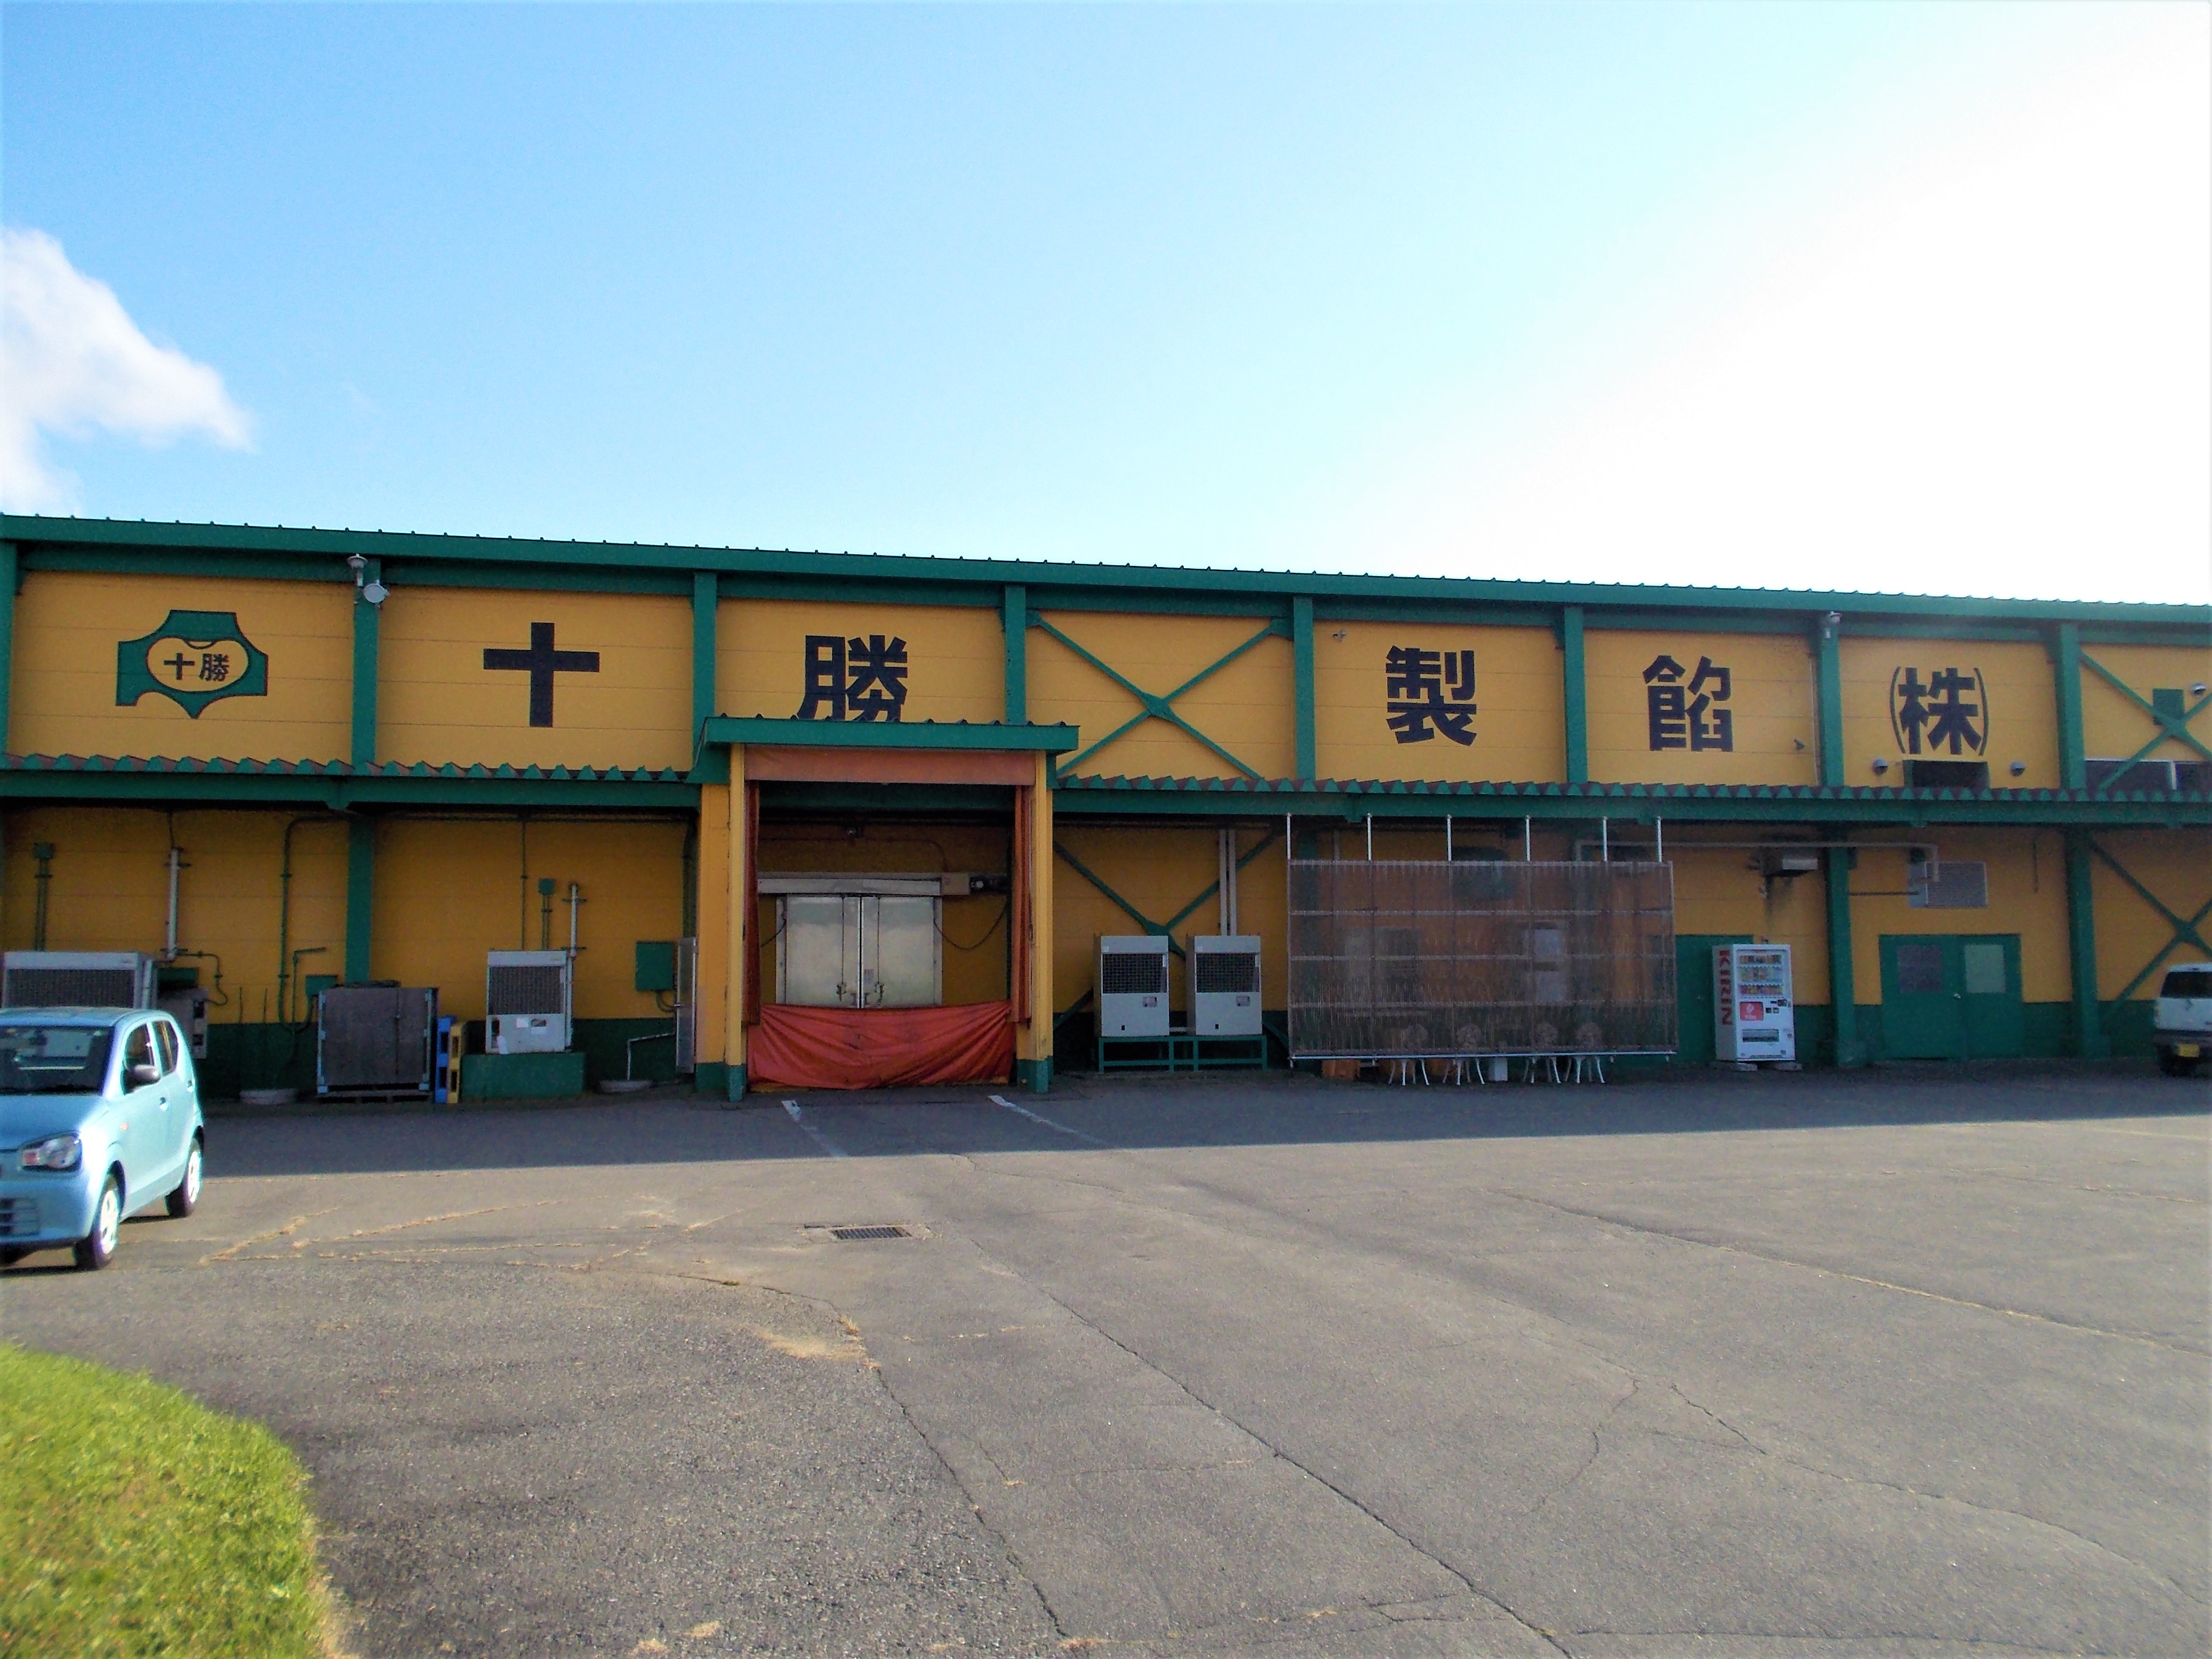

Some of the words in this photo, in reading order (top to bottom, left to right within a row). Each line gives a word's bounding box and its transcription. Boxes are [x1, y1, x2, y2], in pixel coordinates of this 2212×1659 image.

[163, 652, 230, 682] 十勝
[483, 622, 600, 728] 十
[797, 634, 908, 722] 勝
[1386, 646, 1477, 746] 製
[1643, 655, 1733, 752] 餡
[1718, 950, 1733, 1026] KIRIN
